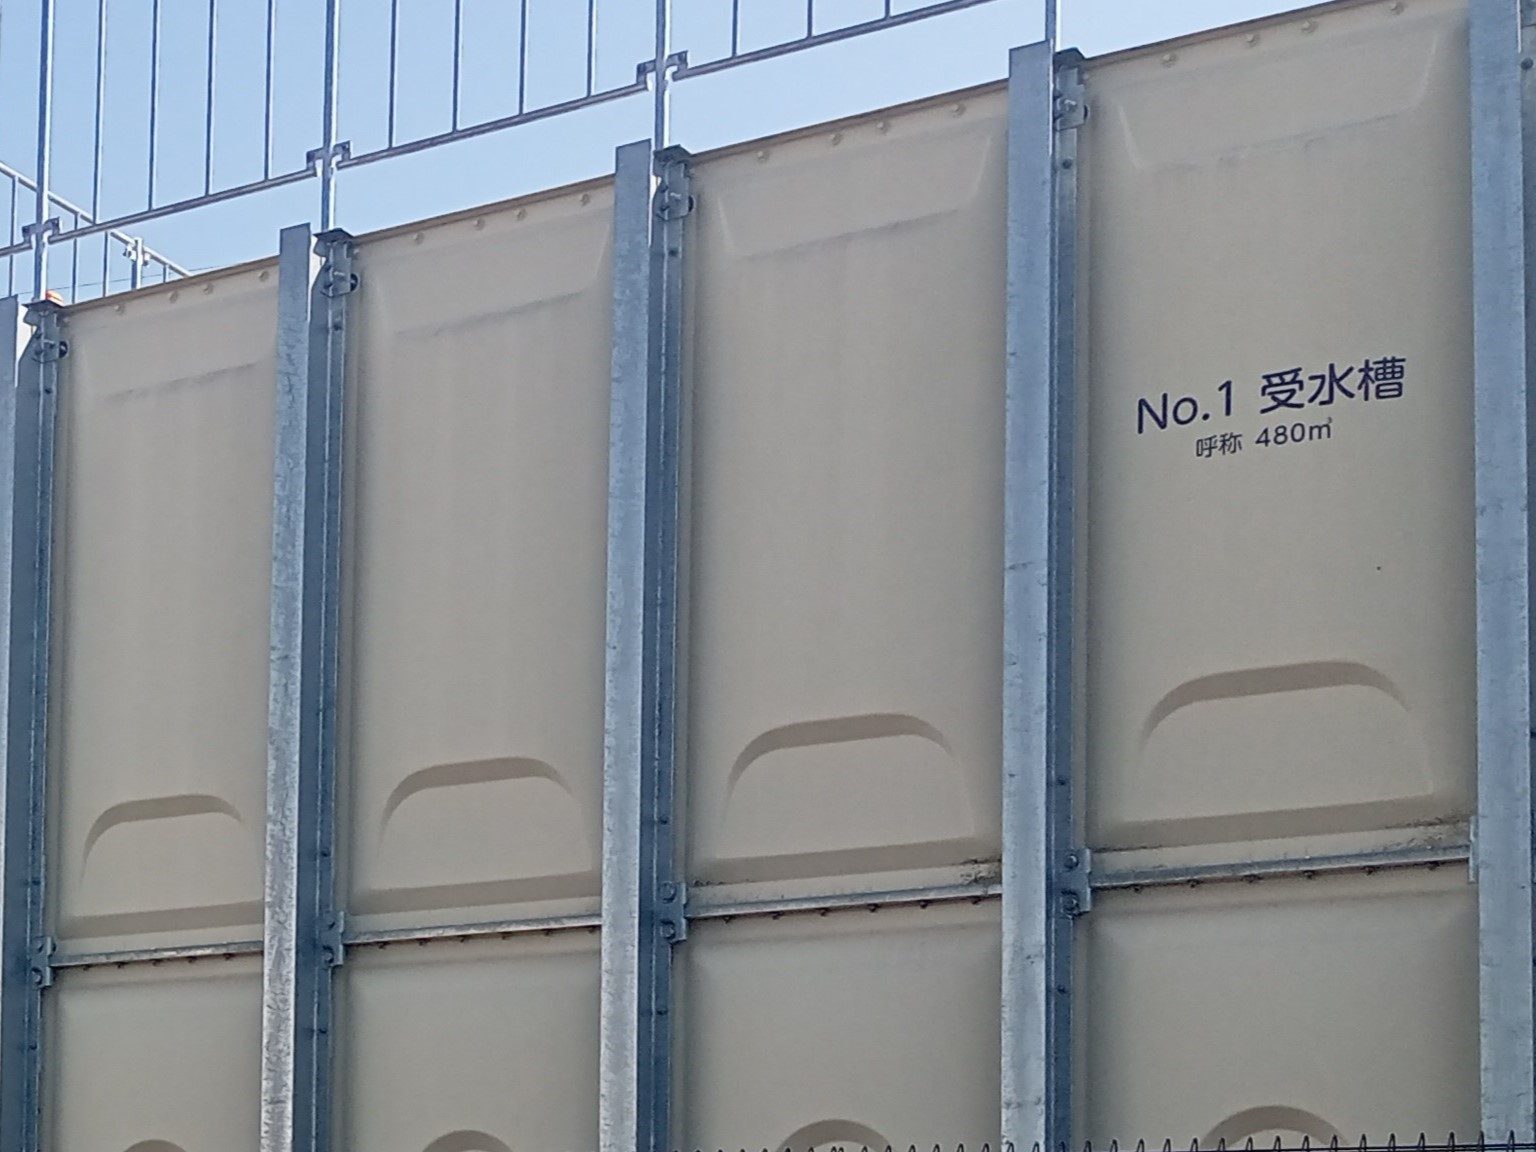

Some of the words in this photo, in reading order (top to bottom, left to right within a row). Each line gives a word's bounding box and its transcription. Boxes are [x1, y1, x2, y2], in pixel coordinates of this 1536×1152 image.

[1137, 380, 1233, 434] No.1
[1259, 356, 1406, 414] 受水槽
[1195, 432, 1243, 458] 呼称
